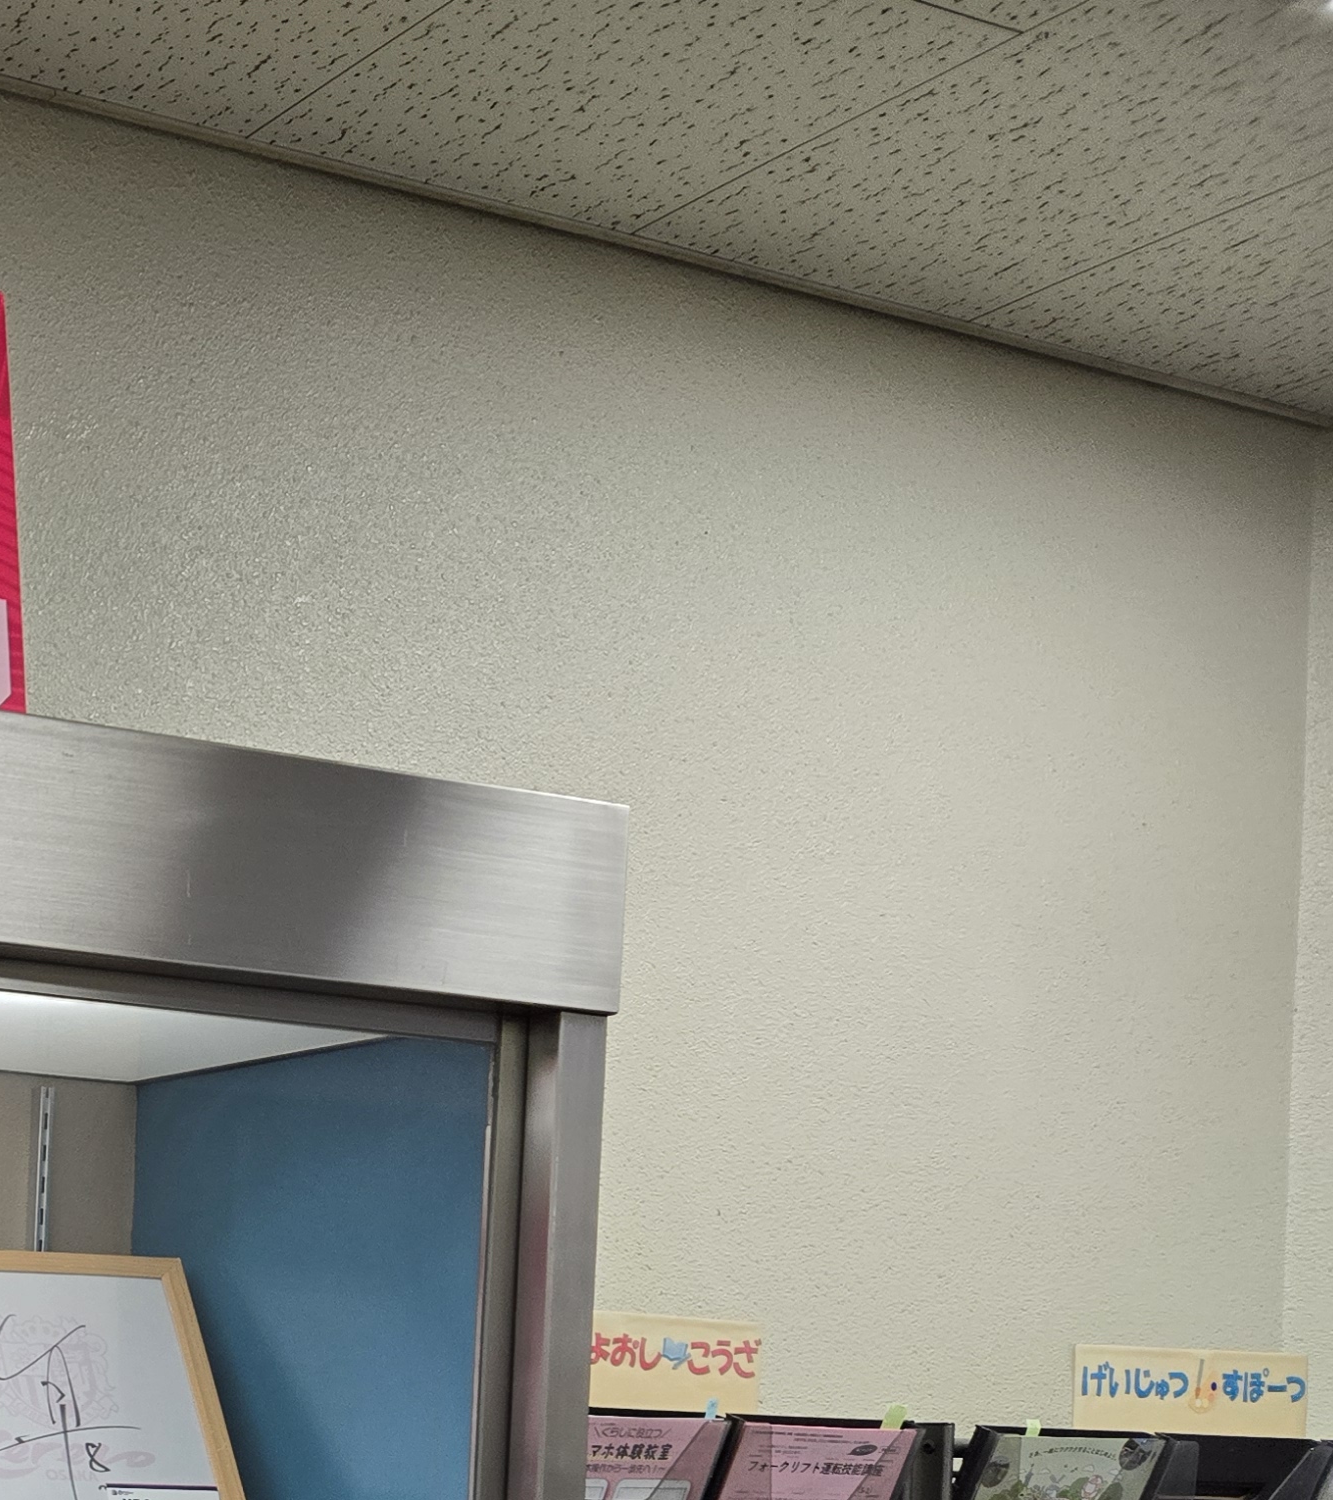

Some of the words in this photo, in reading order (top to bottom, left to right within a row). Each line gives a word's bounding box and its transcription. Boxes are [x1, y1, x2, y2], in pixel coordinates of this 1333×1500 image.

[686, 1338, 763, 1379] こうざ
[1081, 1361, 1190, 1399] げいじゅつ
[1221, 1367, 1307, 1404] すぽーつ
